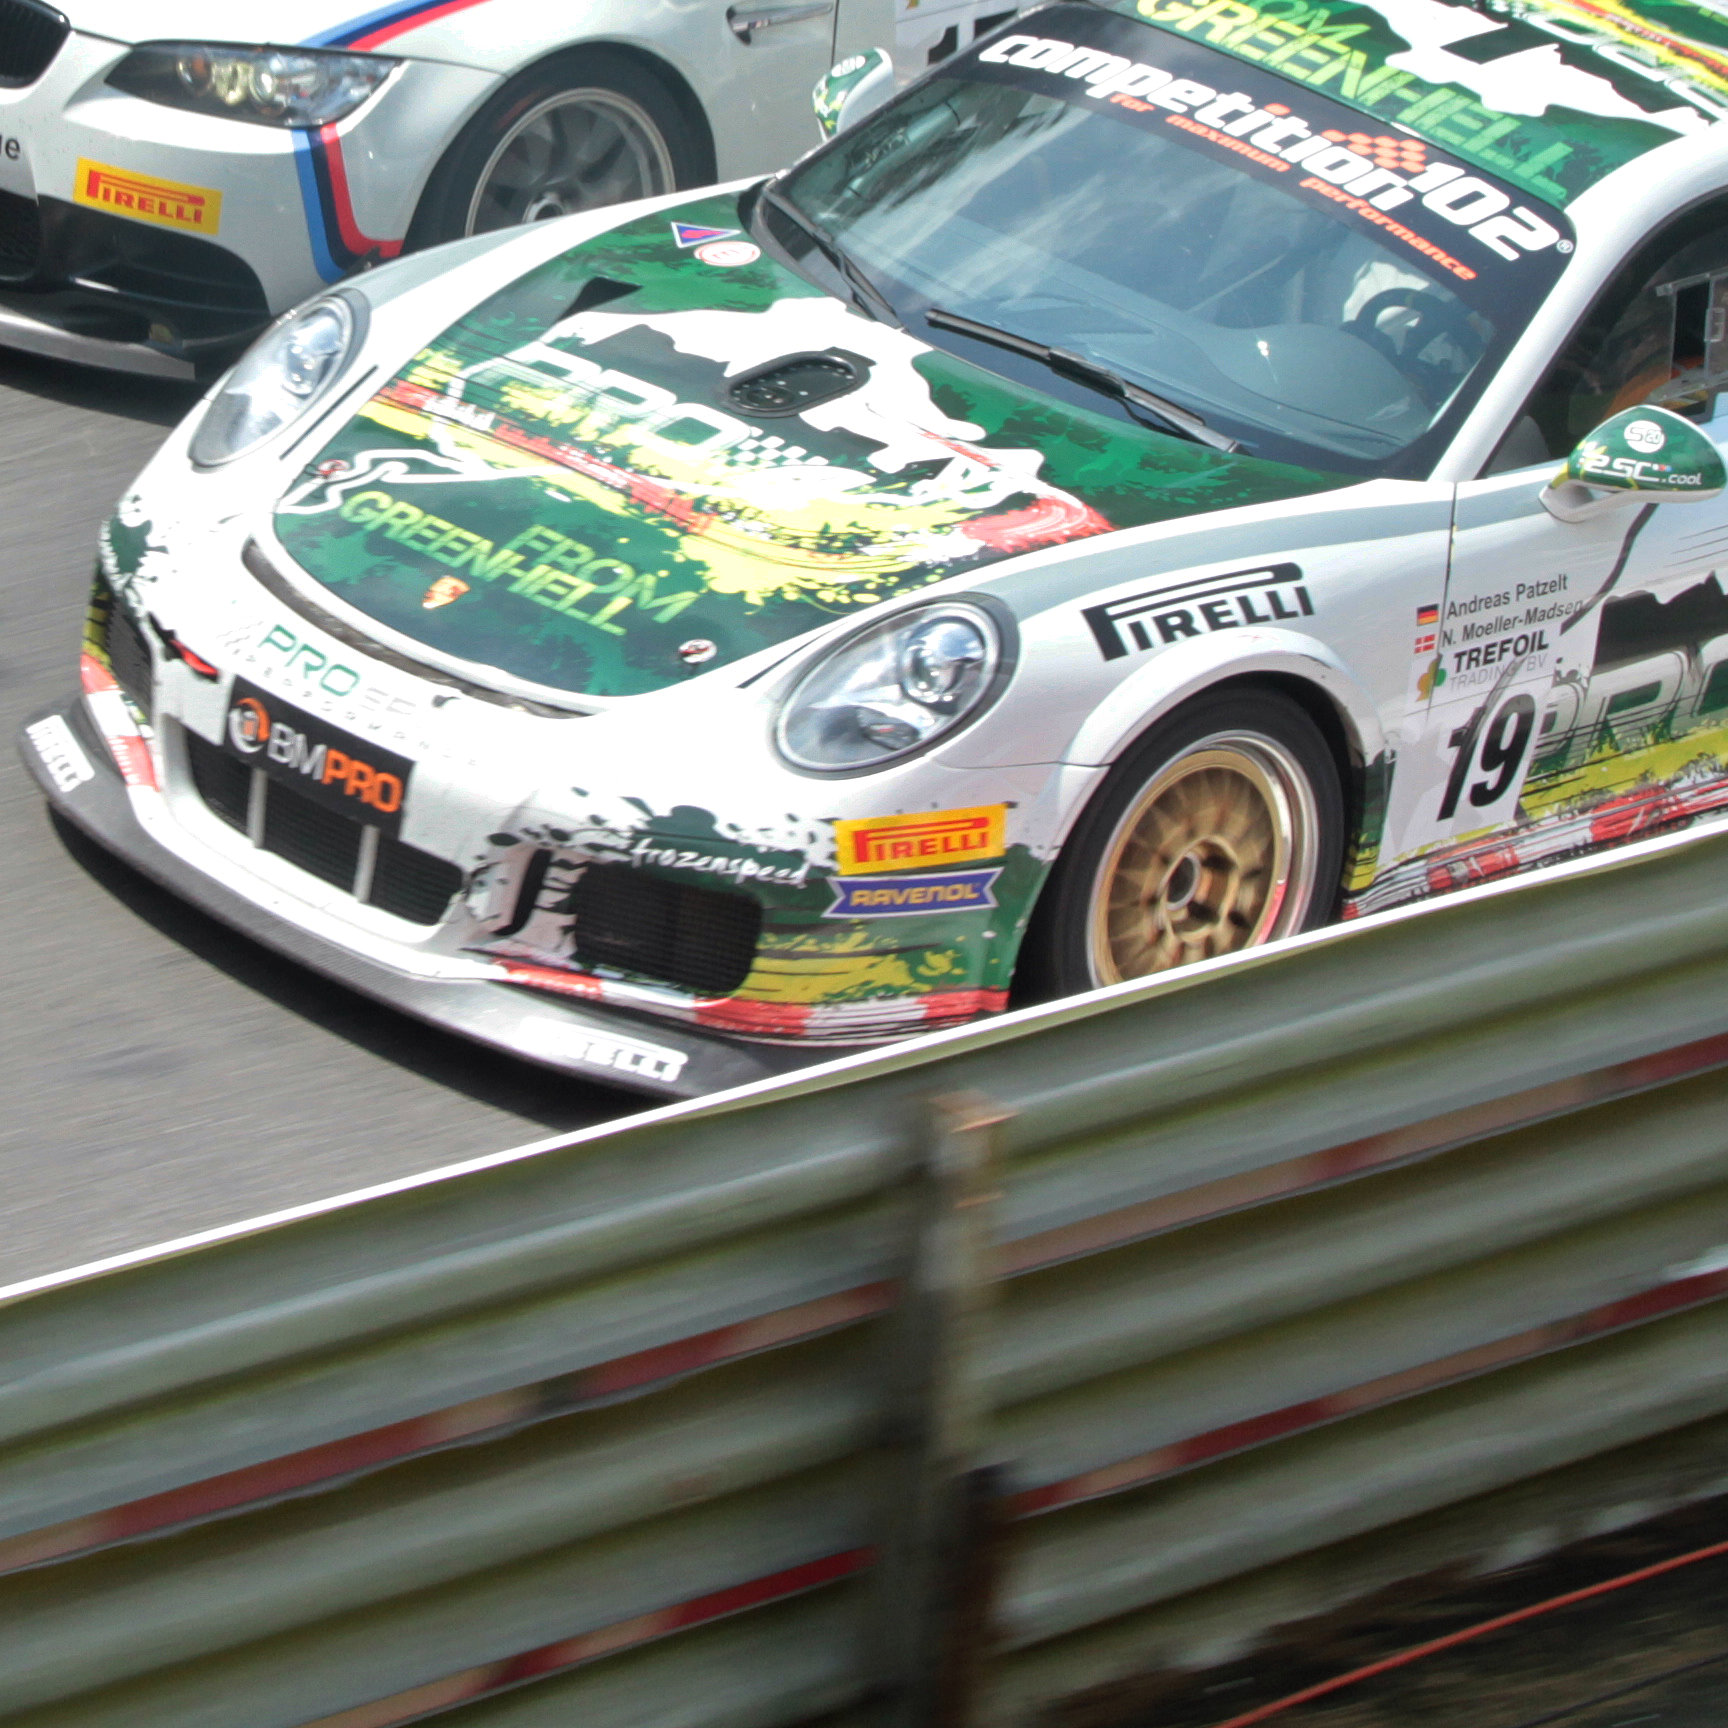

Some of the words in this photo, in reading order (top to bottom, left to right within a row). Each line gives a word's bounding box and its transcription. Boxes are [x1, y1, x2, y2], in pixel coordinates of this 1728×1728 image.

[85, 169, 206, 225] PIRELLI
[1110, 94, 1156, 114] for
[1165, 114, 1290, 172] maximum
[1300, 178, 1477, 280] performance
[339, 491, 633, 636] GREENHELL
[502, 524, 700, 624] FROM
[1081, 561, 1315, 662] PIRELLI
[1441, 627, 1457, 648] N.
[1462, 599, 1585, 643] Moeller-Madsen
[1446, 589, 1511, 620] Andreas
[1515, 573, 1569, 602] Patzelt
[1454, 629, 1550, 673] TREFOIL
[1436, 692, 1536, 823] 19
[628, 837, 811, 889] frozenspeed
[853, 816, 990, 864] PIRELLI
[850, 881, 981, 908] RAVENOL
